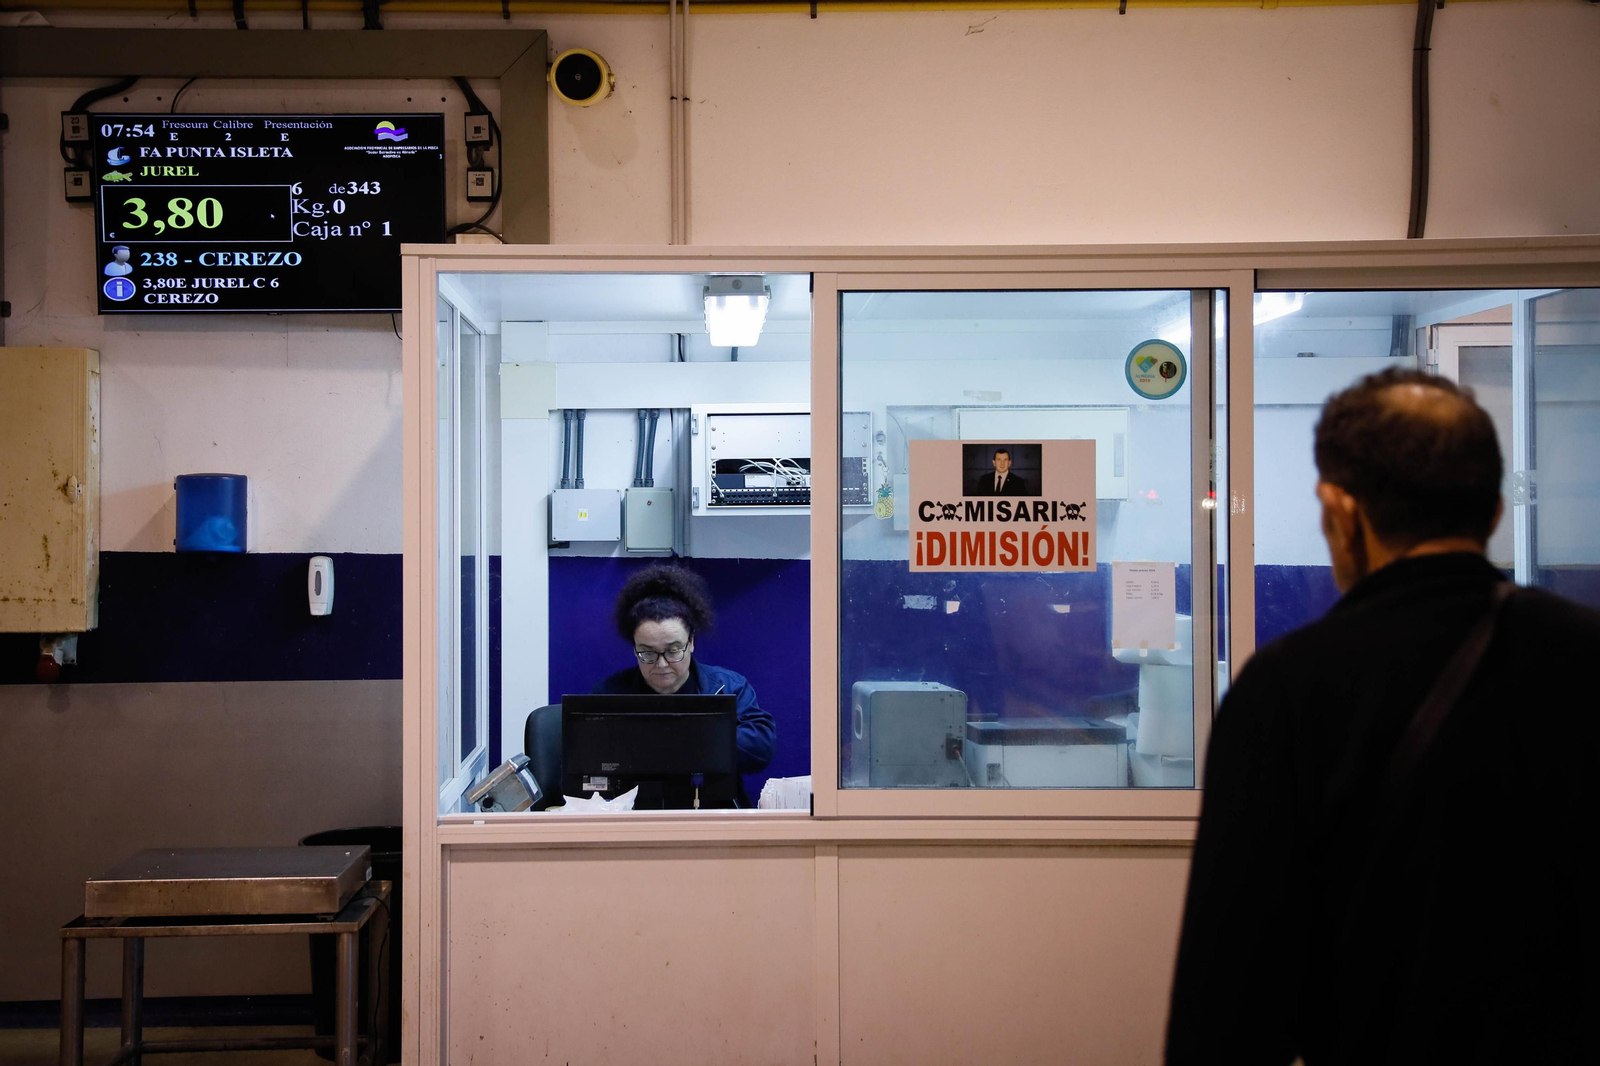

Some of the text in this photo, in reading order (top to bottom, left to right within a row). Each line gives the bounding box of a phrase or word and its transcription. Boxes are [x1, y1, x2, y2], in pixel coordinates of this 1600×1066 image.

[101, 124, 154, 137] 07:54
[170, 133, 178, 141] E
[281, 133, 289, 141] E
[140, 147, 293, 157] FA PUNTA ISLETA
[140, 166, 199, 176] JUREL
[293, 182, 302, 195] 6
[347, 182, 380, 194] 343
[123, 198, 223, 235] 3,80
[294, 221, 342, 240] Caja
[382, 221, 391, 236] 1
[141, 252, 177, 266] 238
[199, 252, 302, 266] CEREZO
[143, 278, 279, 290] 3,80E JUREL C 6
[144, 293, 218, 304] CEREZO
[916, 525, 1089, 566] ¡DIMISIÓN!
